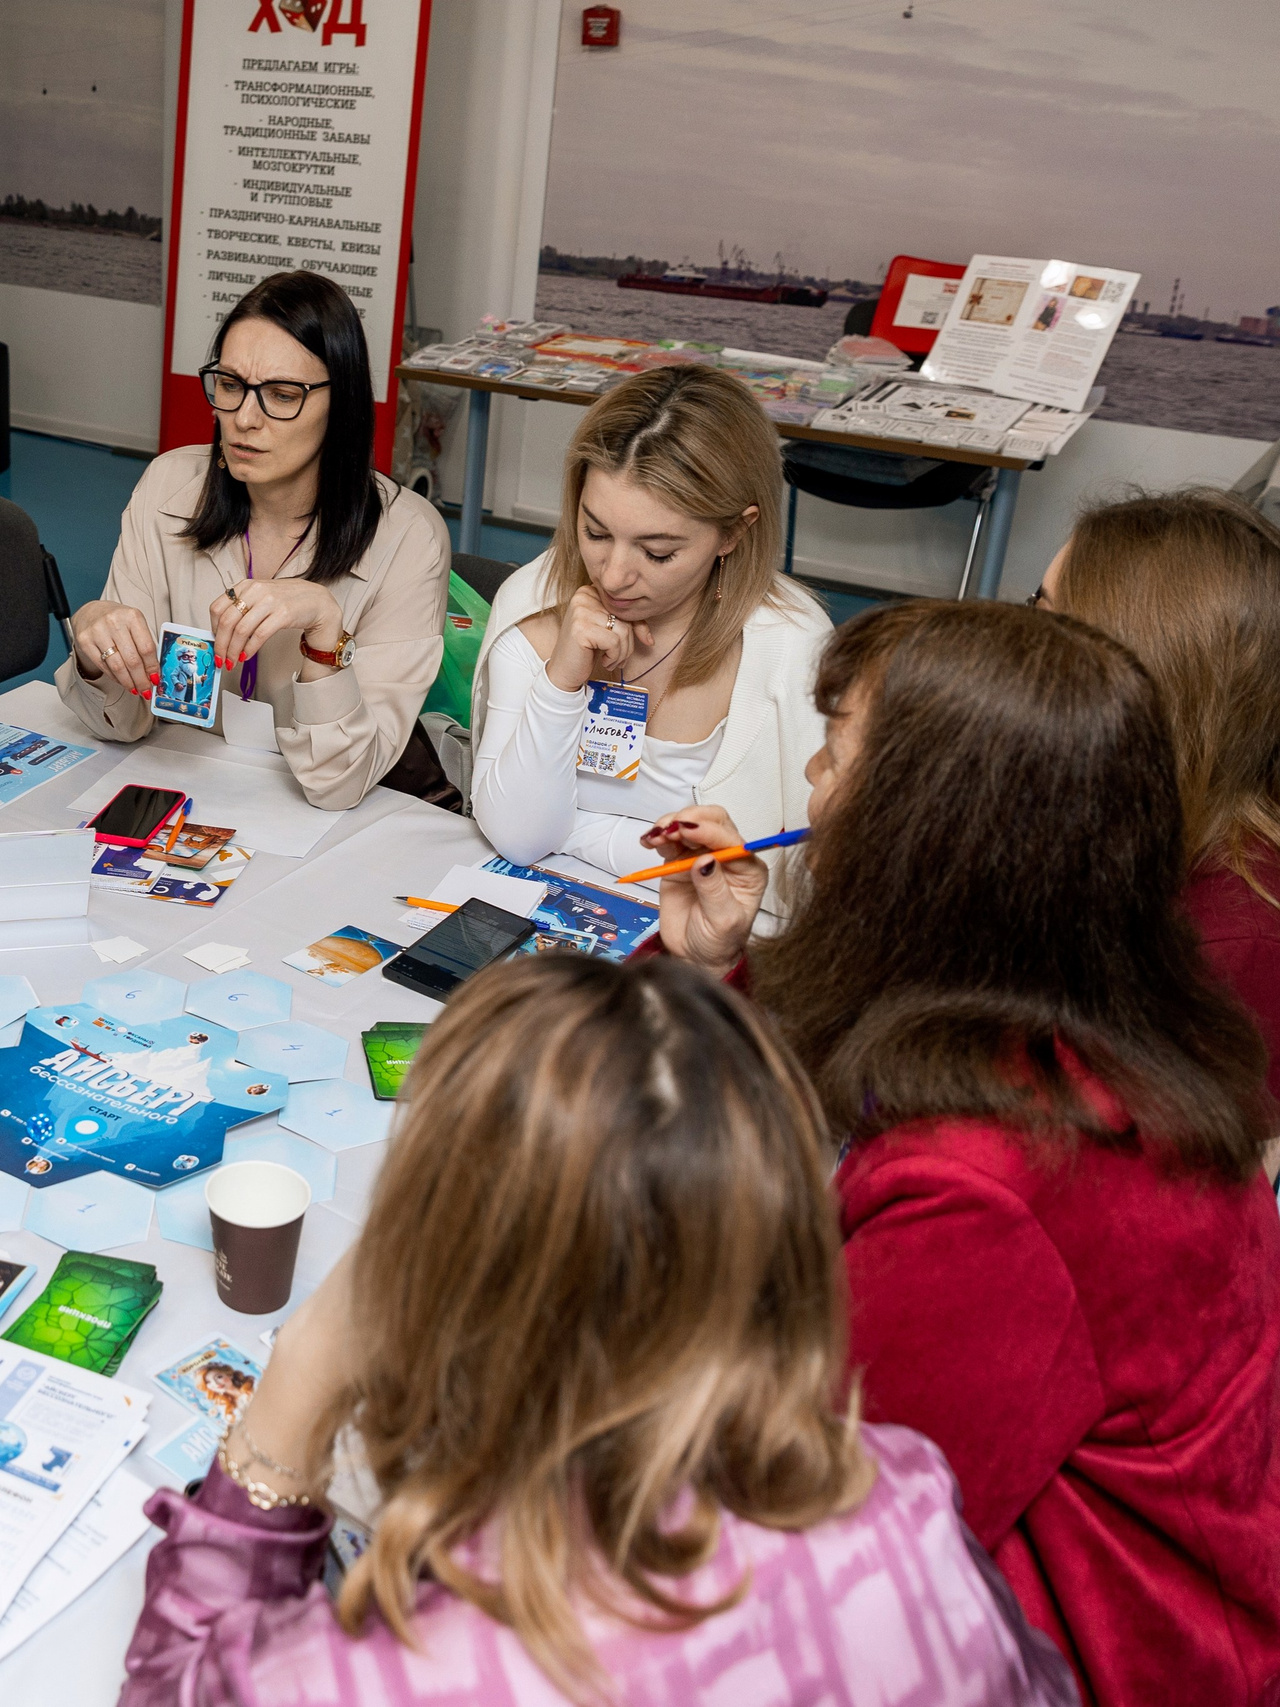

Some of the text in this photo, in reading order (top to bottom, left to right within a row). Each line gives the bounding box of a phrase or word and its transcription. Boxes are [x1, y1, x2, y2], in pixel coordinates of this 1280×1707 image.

[242, 58, 360, 75] ПРЕДЛАГАЕМ ИГРЫ:
[233, 79, 376, 99] ТРАНСФОРМАЦИОННЫЕ,
[240, 93, 357, 110] ПСИХОЛОГИЧЕСКИЕ
[267, 114, 335, 130] НАРОДНЫЕ,
[223, 124, 371, 145] ТРАДИЦИОННЫЕ ЗАБАВЫ
[237, 145, 362, 166] ИНТЕЛЛЕКТУАЛЬНЫЕ,
[252, 159, 336, 176] МОЗГОКРУТКИ
[242, 178, 353, 198] ИНДИВИДУАЛЬНЫЕ
[250, 191, 334, 209] И ГРУППОВЫЕ
[208, 207, 382, 234] ПРАЗДНИЧНО-КАРНАВАЛЬНЫЕ
[206, 228, 382, 256] ТВОРЧЕСКИЕ, КВЕСТЫ, КВИЗЫ
[206, 249, 378, 278] РАЗВИВАЮЩИЕ, ОБУЧАЮЩИЕ
[207, 270, 257, 285] ЛИЧНЫЕ
[125, 989, 142, 999] 6
[228, 993, 249, 1001] 6
[38, 1048, 217, 1118] АЙСБЕРГ
[29, 1065, 179, 1126] бессознательного
[88, 1105, 122, 1122] СТАРТ
[58, 1304, 112, 1330] ПРОЕКЦИЯ
